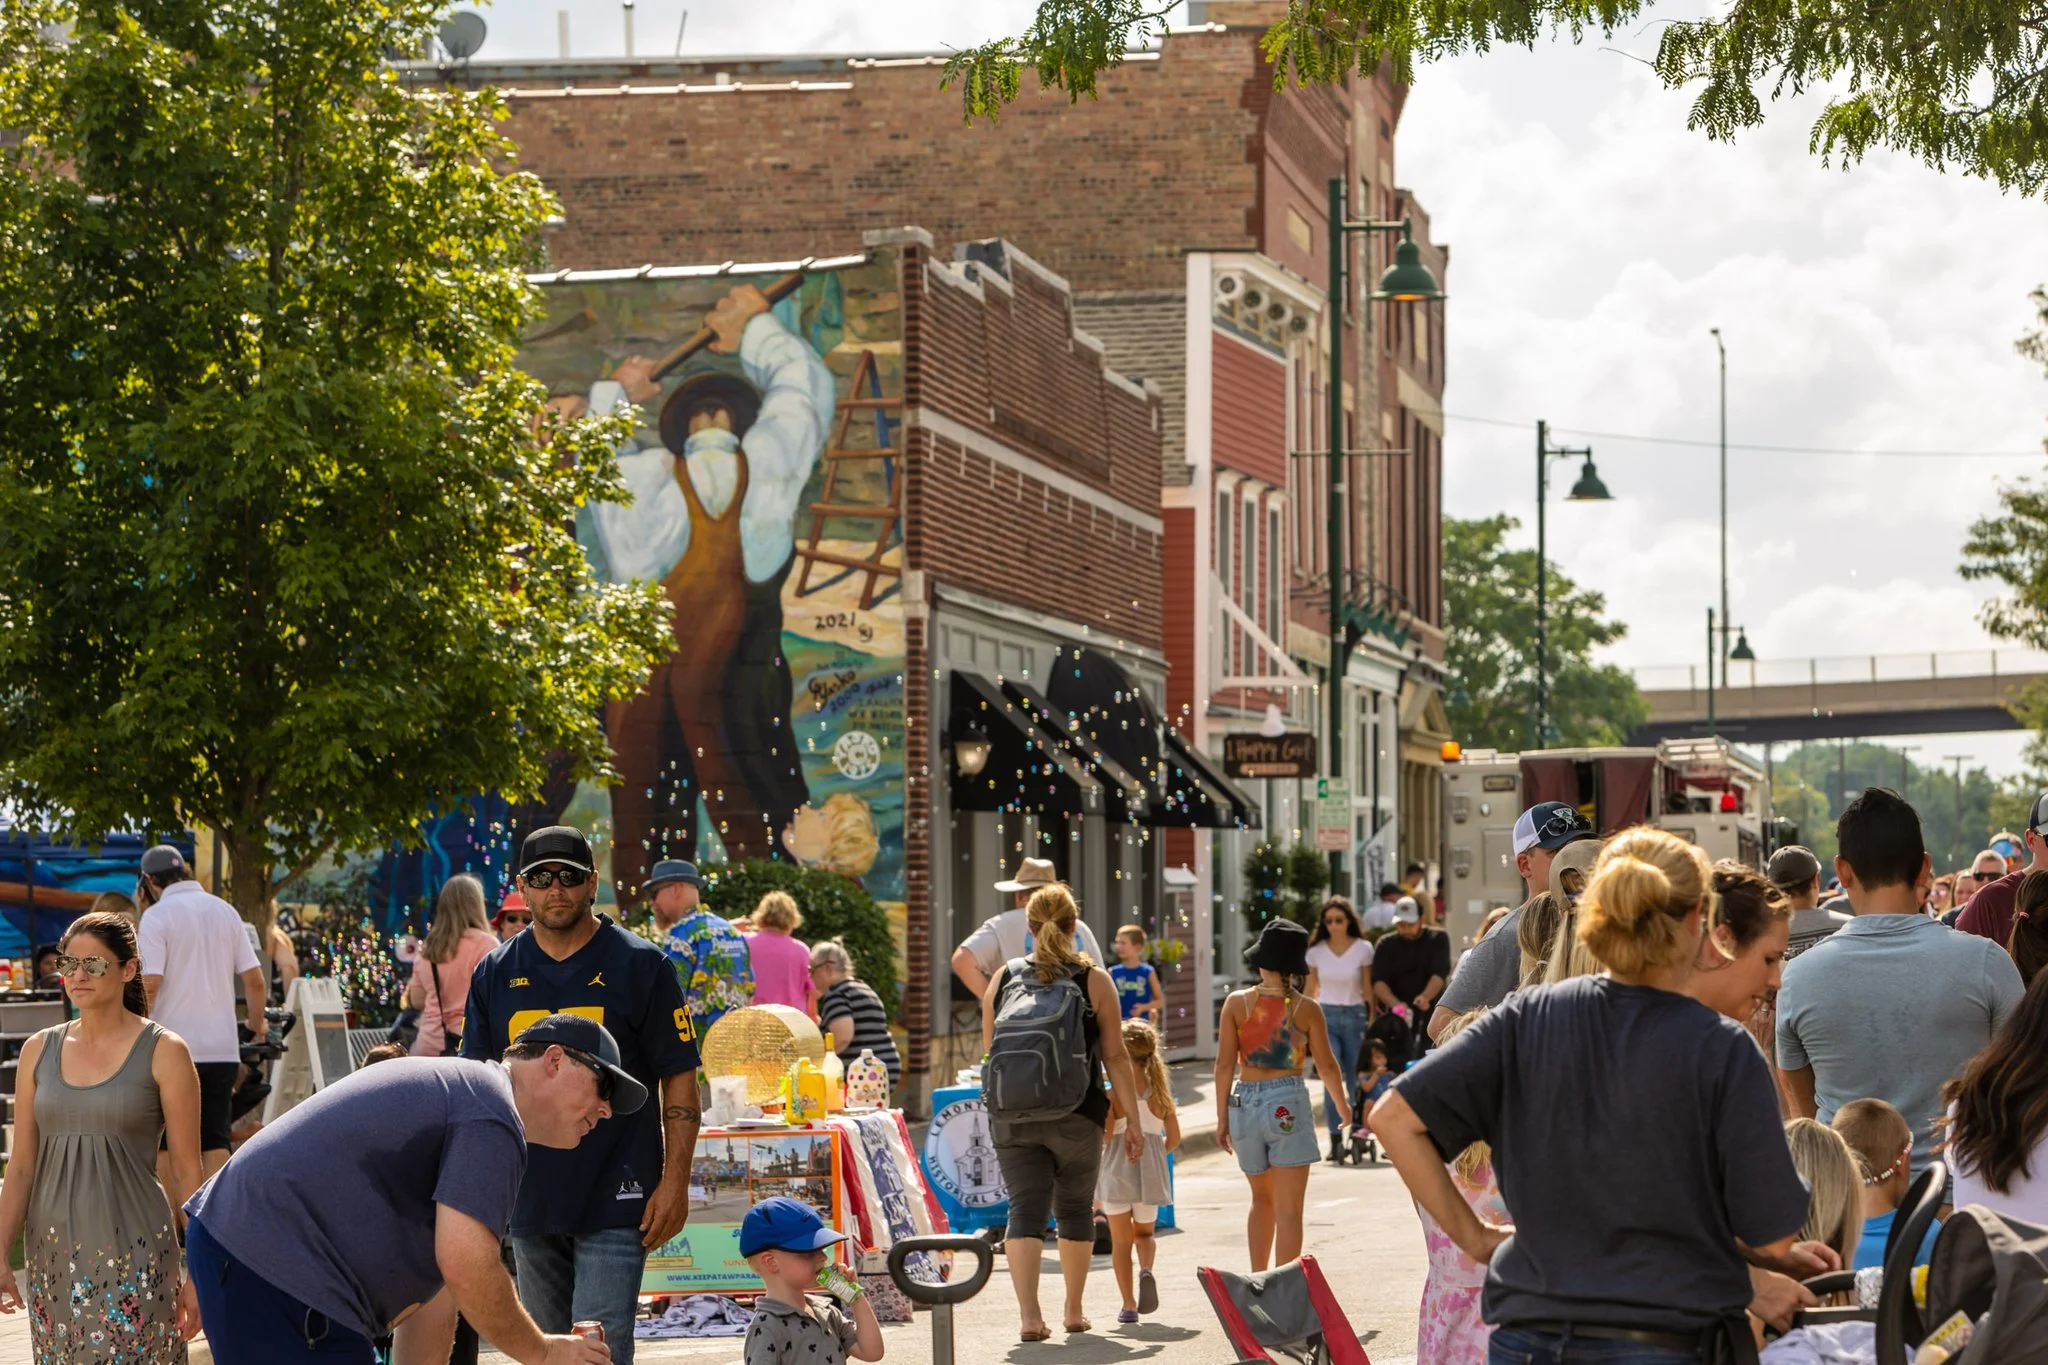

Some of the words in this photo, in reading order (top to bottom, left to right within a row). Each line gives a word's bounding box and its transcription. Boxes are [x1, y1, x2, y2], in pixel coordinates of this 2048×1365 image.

[815, 611, 856, 630] 2021
[930, 1102, 983, 1137] LEMONT
[928, 1156, 988, 1205] HISTORICAL
[722, 1258, 750, 1267] SUND
[666, 1272, 762, 1282] WWW.KEEPATAWPARA
